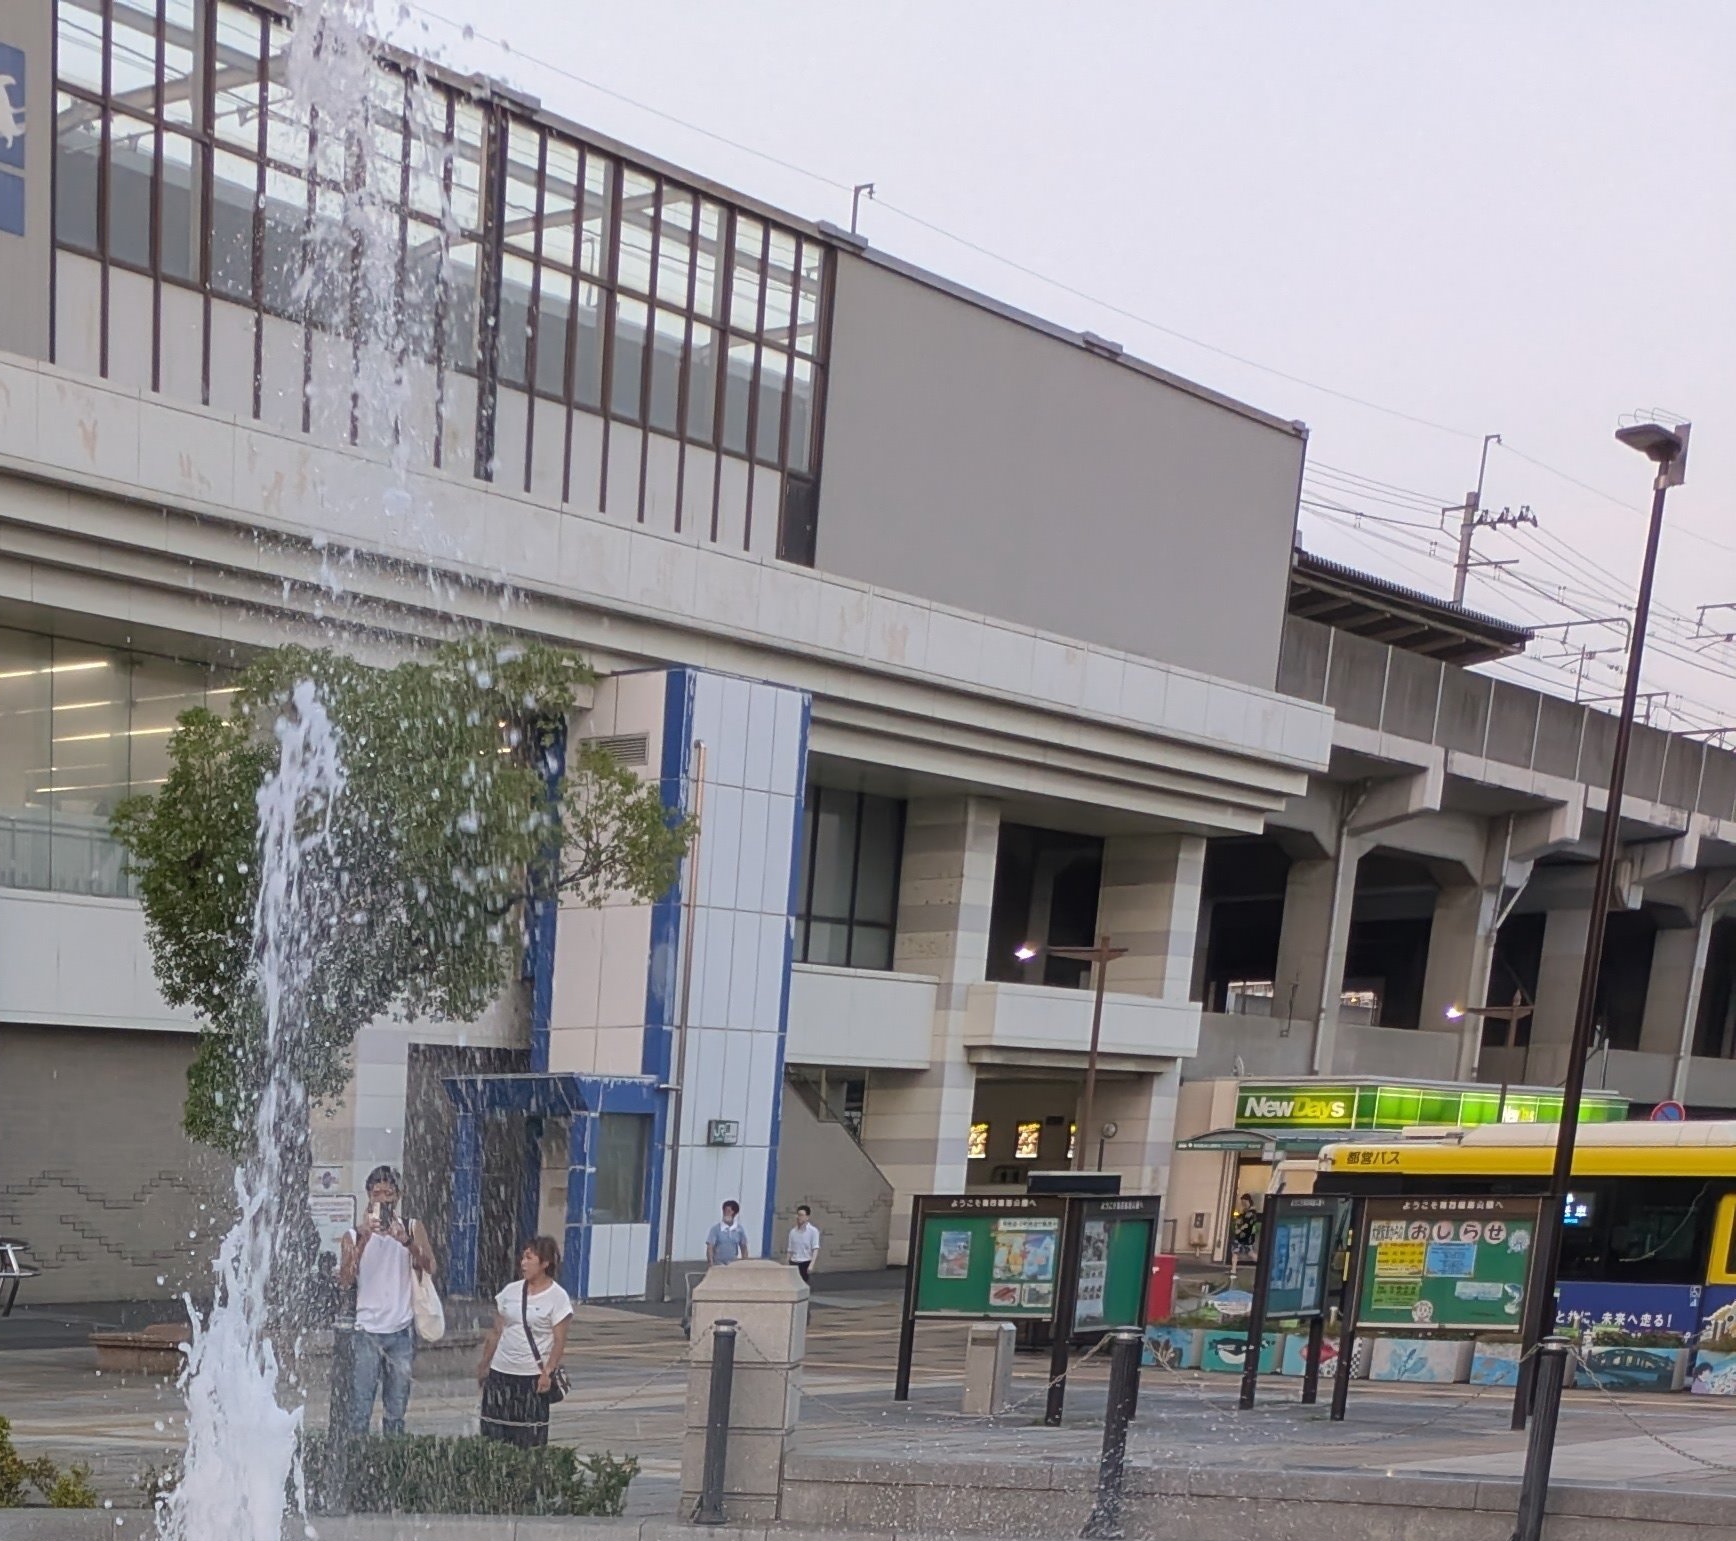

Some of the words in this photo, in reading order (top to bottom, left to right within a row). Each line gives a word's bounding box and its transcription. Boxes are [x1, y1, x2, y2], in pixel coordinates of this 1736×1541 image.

[1244, 1096, 1345, 1118] NewDays
[1346, 1151, 1401, 1166] 都営バス
[1411, 1224, 1504, 1240] おしらせ
